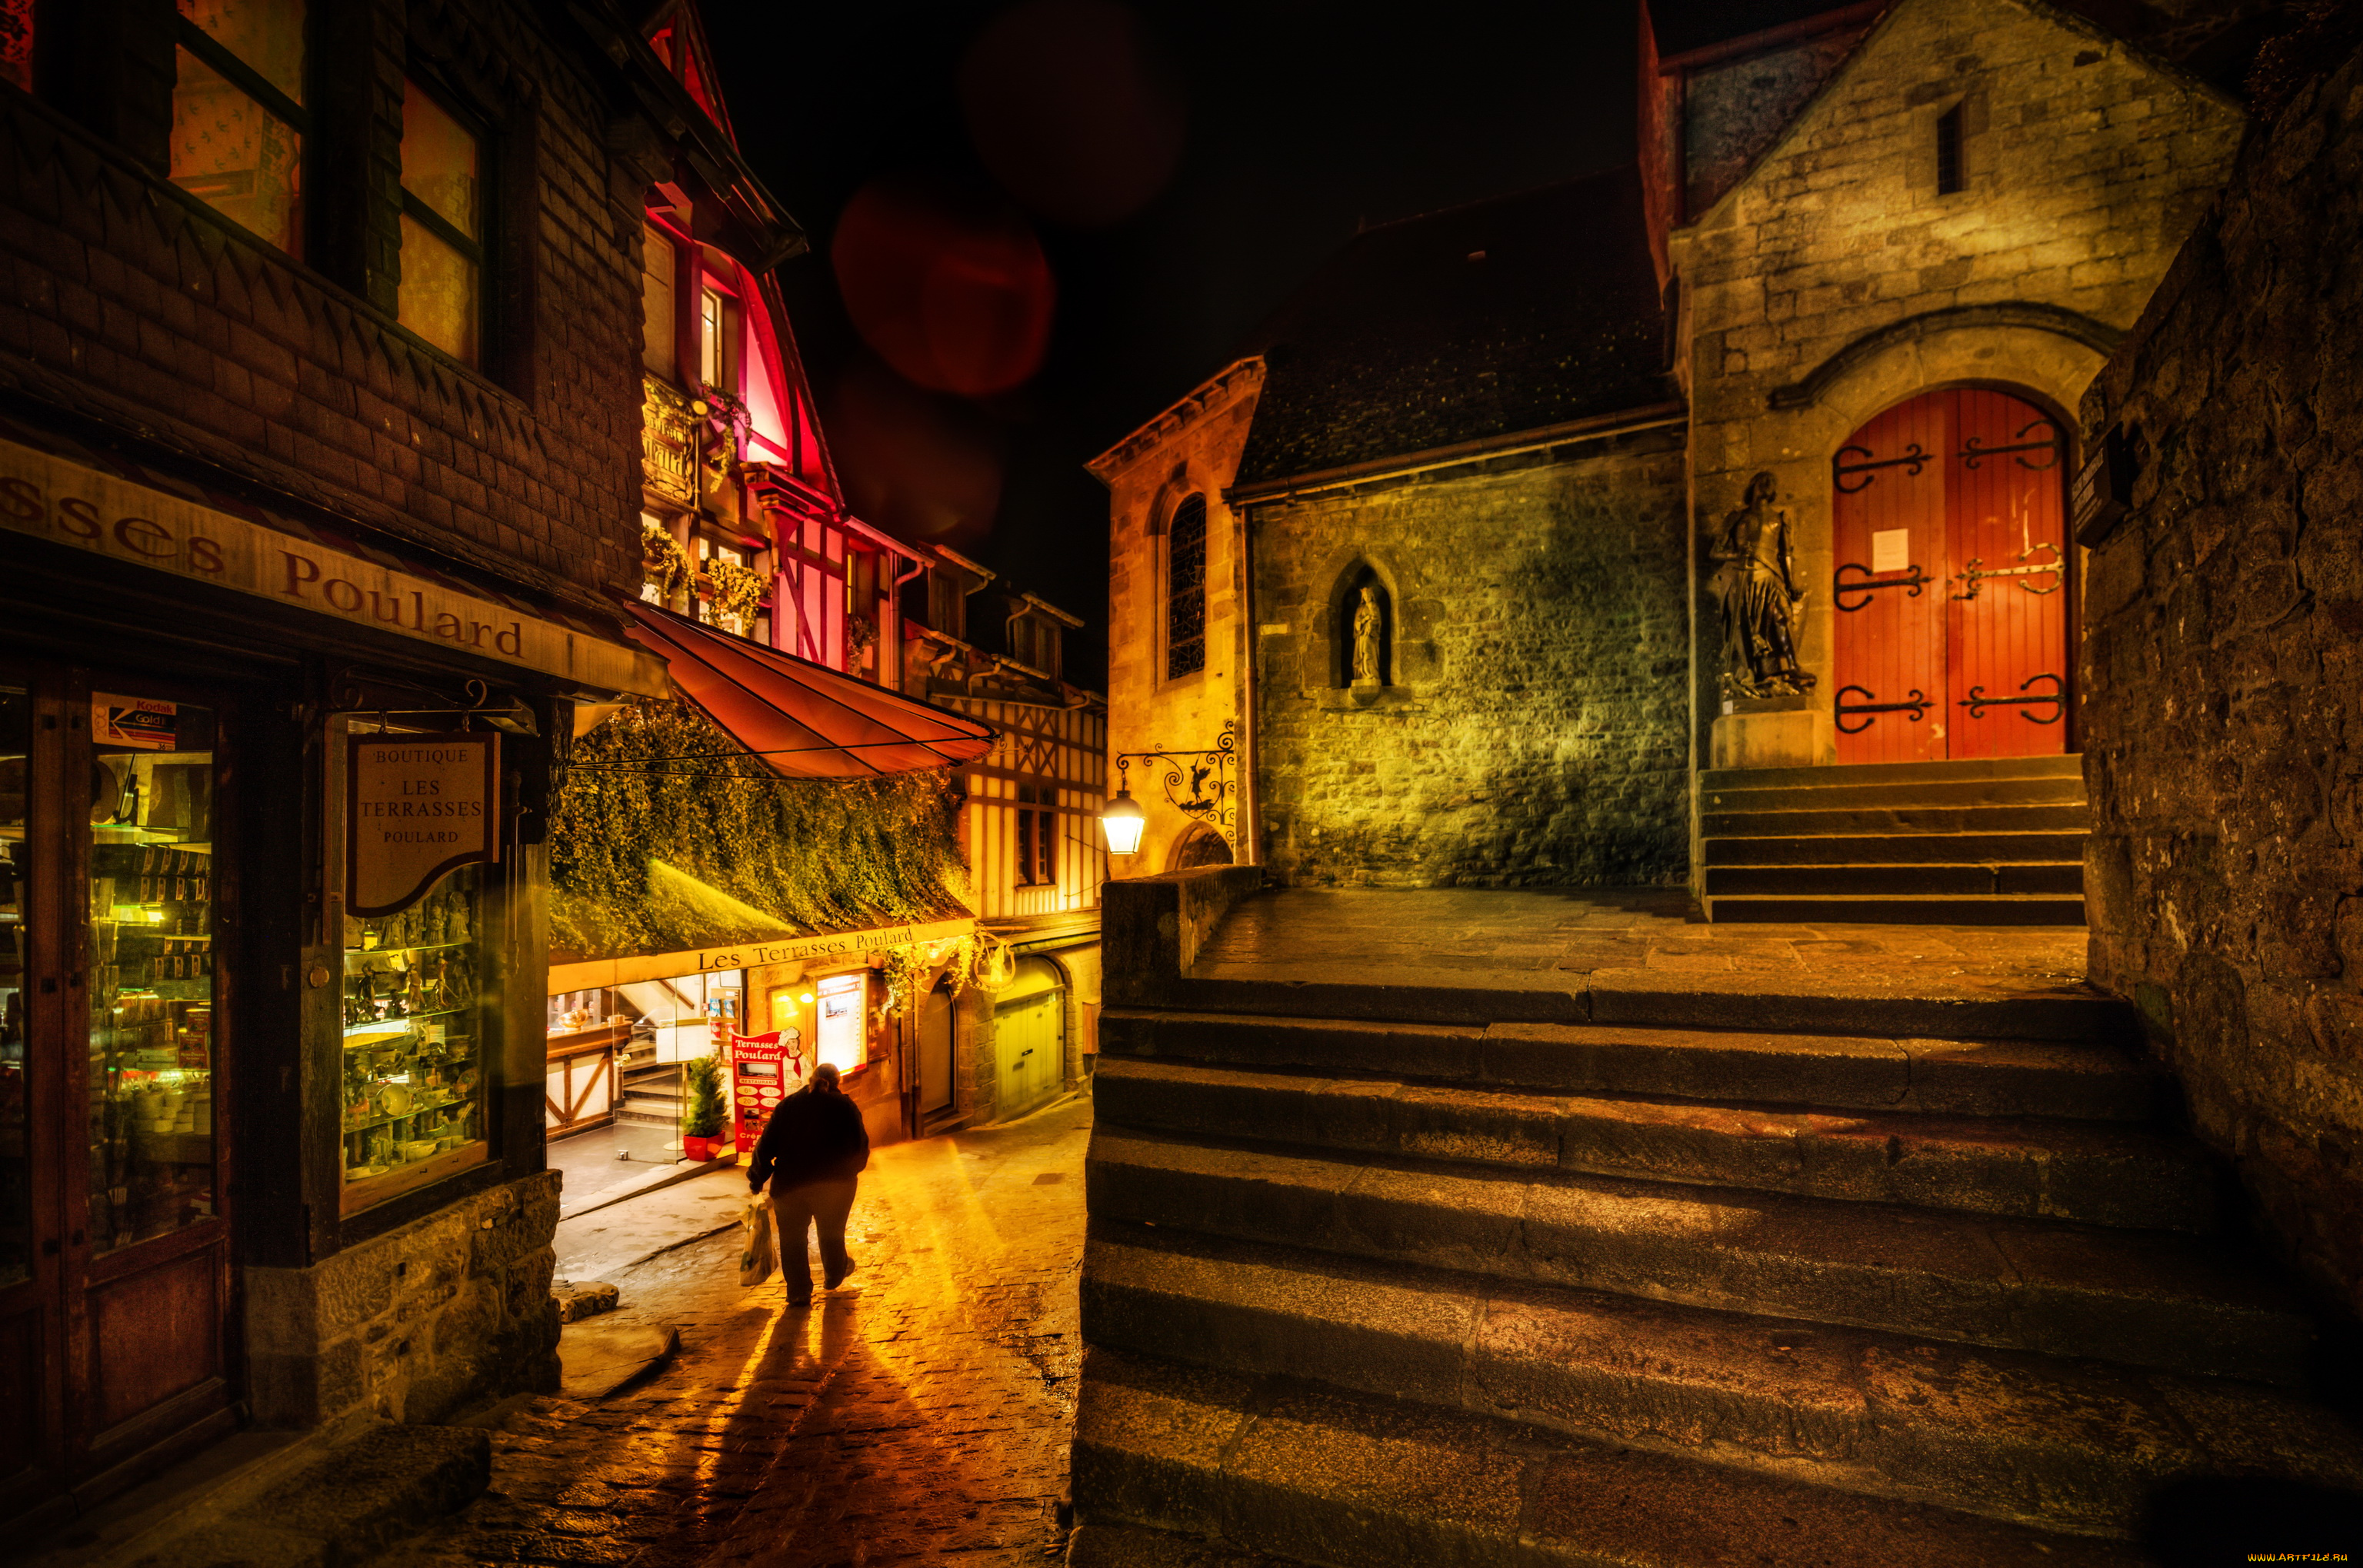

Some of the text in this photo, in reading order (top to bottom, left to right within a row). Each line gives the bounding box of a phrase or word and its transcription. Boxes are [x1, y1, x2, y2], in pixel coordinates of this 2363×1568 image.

[278, 549, 526, 659] Poulard
[136, 700, 173, 714] Kodak
[135, 714, 160, 725] Gold
[375, 749, 468, 764] BOUTIQUE
[403, 780, 440, 795] LES
[360, 801, 482, 817] TERRASSES
[384, 831, 458, 843] POULARD
[698, 927, 913, 970] Les Terrasses Poulard
[735, 1040, 778, 1049] Terrasses
[734, 1050, 782, 1060] Poulard
